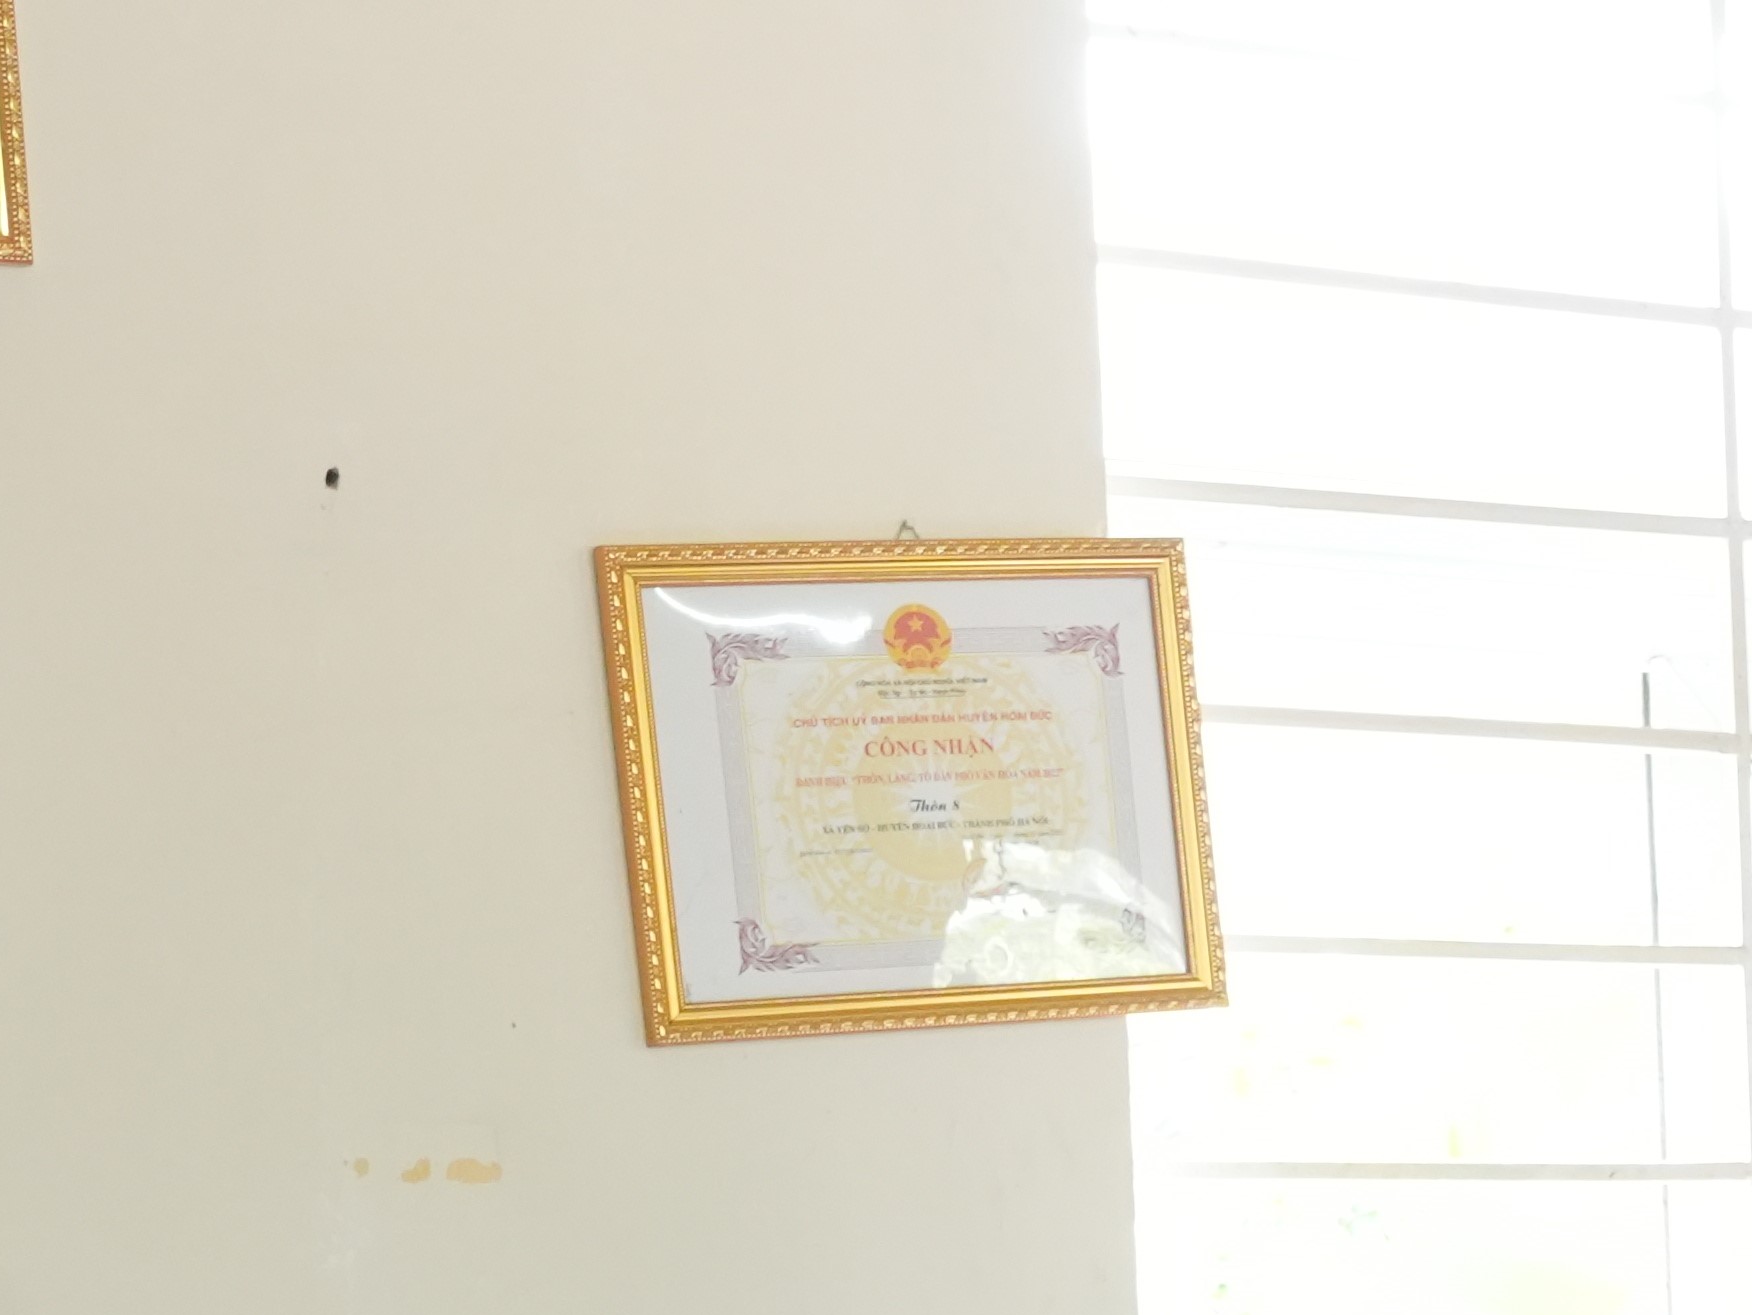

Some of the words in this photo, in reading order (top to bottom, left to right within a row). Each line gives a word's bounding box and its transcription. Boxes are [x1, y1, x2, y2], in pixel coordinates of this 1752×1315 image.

[864, 735, 928, 758] CÔNG
[933, 735, 995, 759] NHẬN
[910, 798, 946, 813] Thôn
[952, 799, 960, 811] 8
